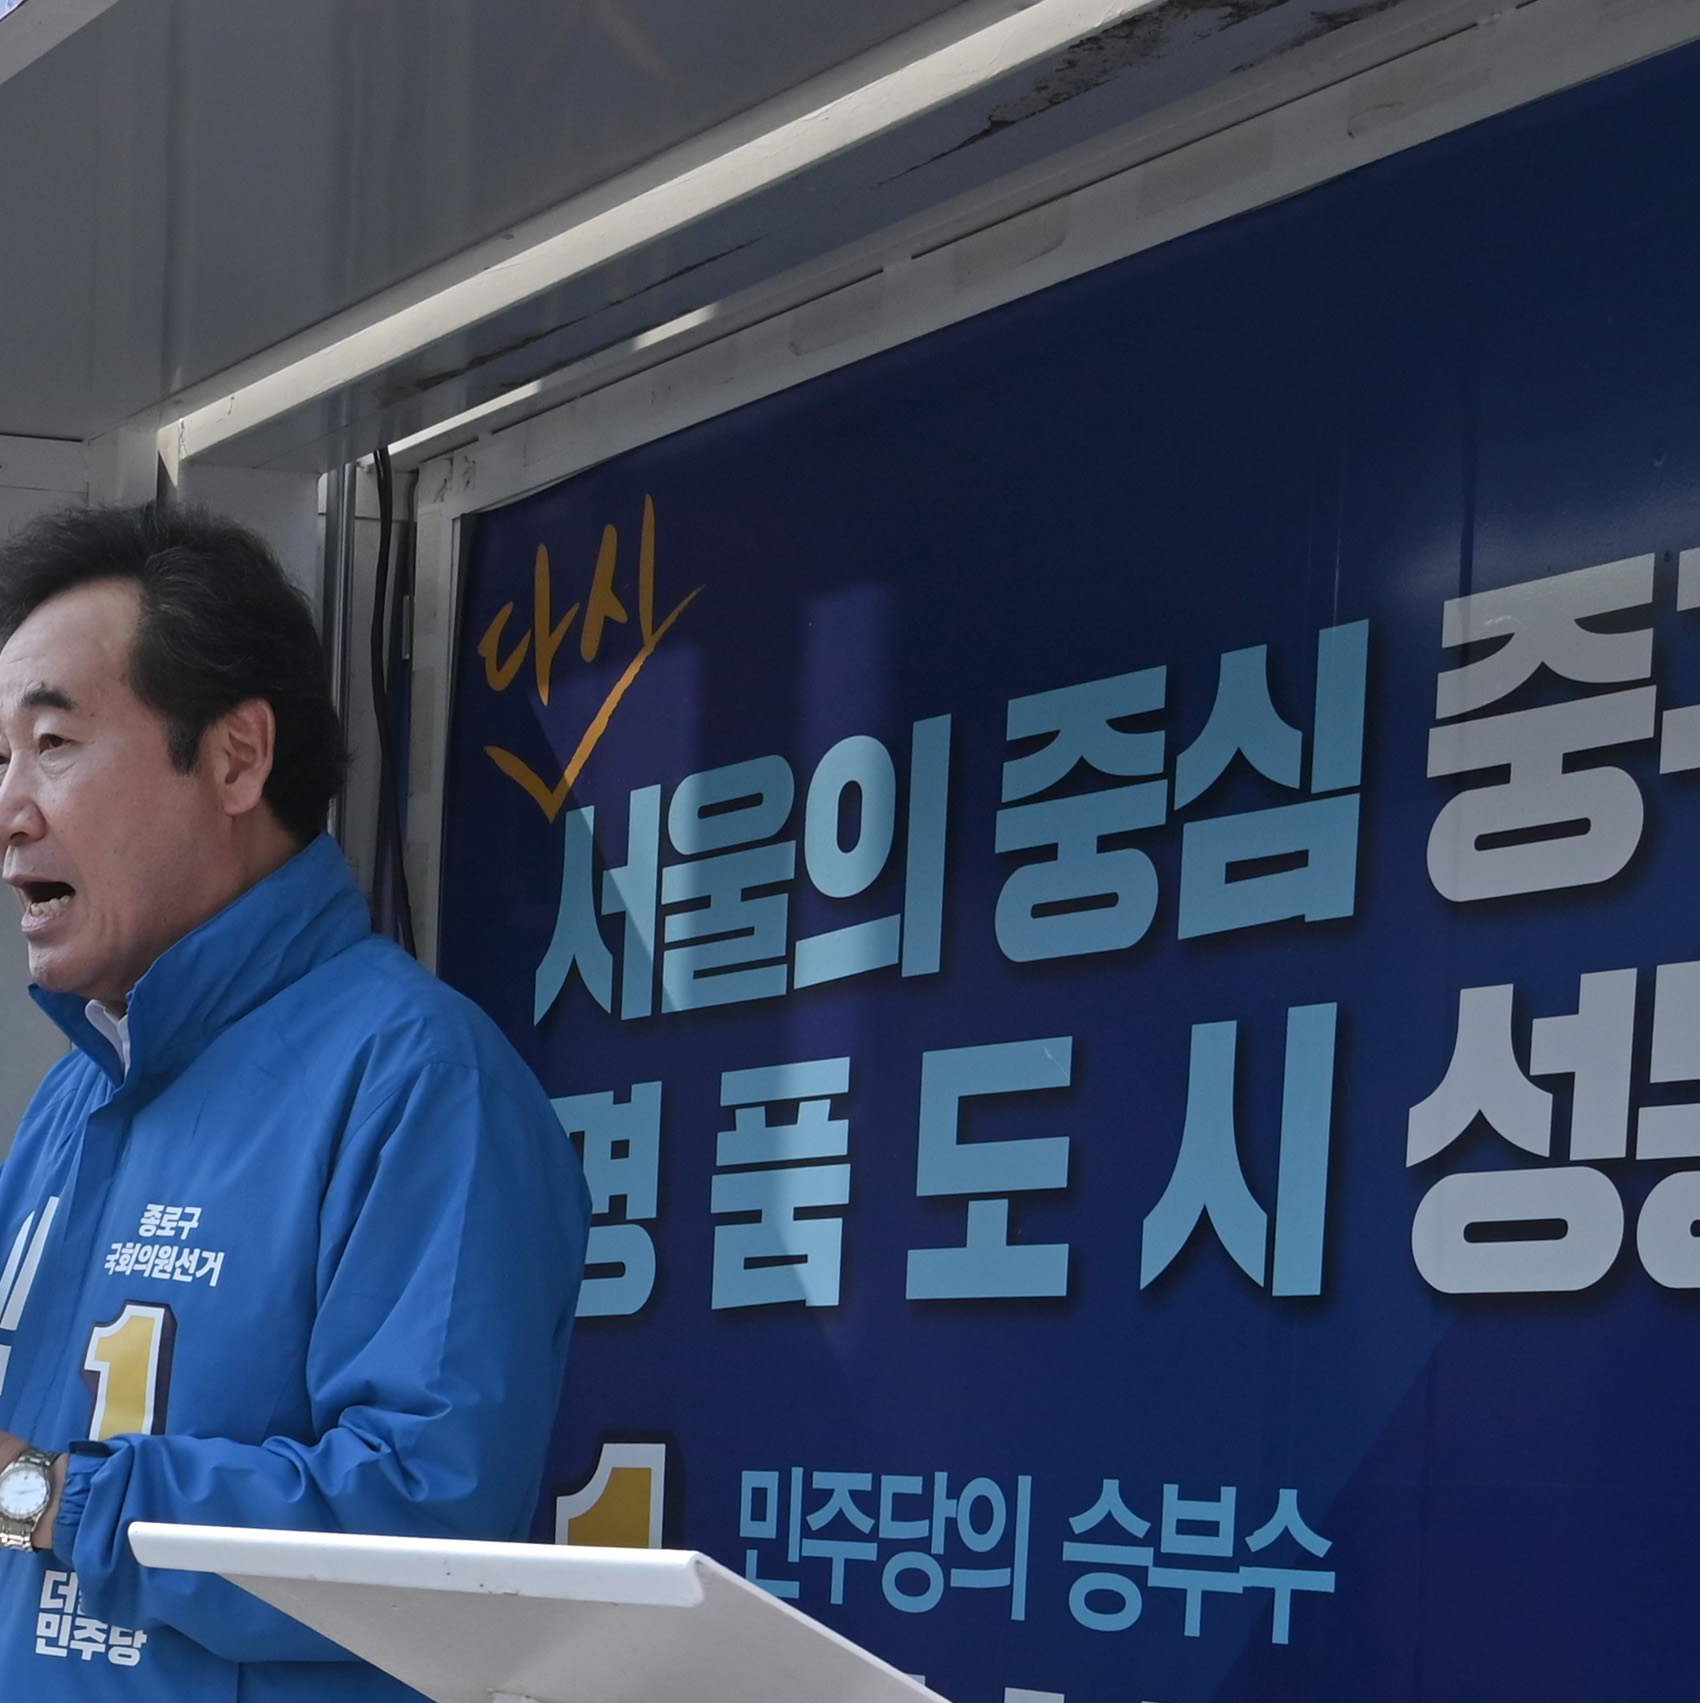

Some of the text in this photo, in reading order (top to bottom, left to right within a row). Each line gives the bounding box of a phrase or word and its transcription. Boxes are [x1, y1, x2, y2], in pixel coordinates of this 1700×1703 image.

[478, 493, 655, 706] 다시
[533, 713, 953, 1027] 서울의
[993, 618, 1371, 964] 중심
[104, 1241, 225, 1288] 국회의원선거
[138, 1202, 203, 1242] 종로구
[83, 1302, 172, 1442] 1
[736, 1466, 1336, 1646] 민주당의 승부수
[34, 1612, 148, 1667] 민주당
